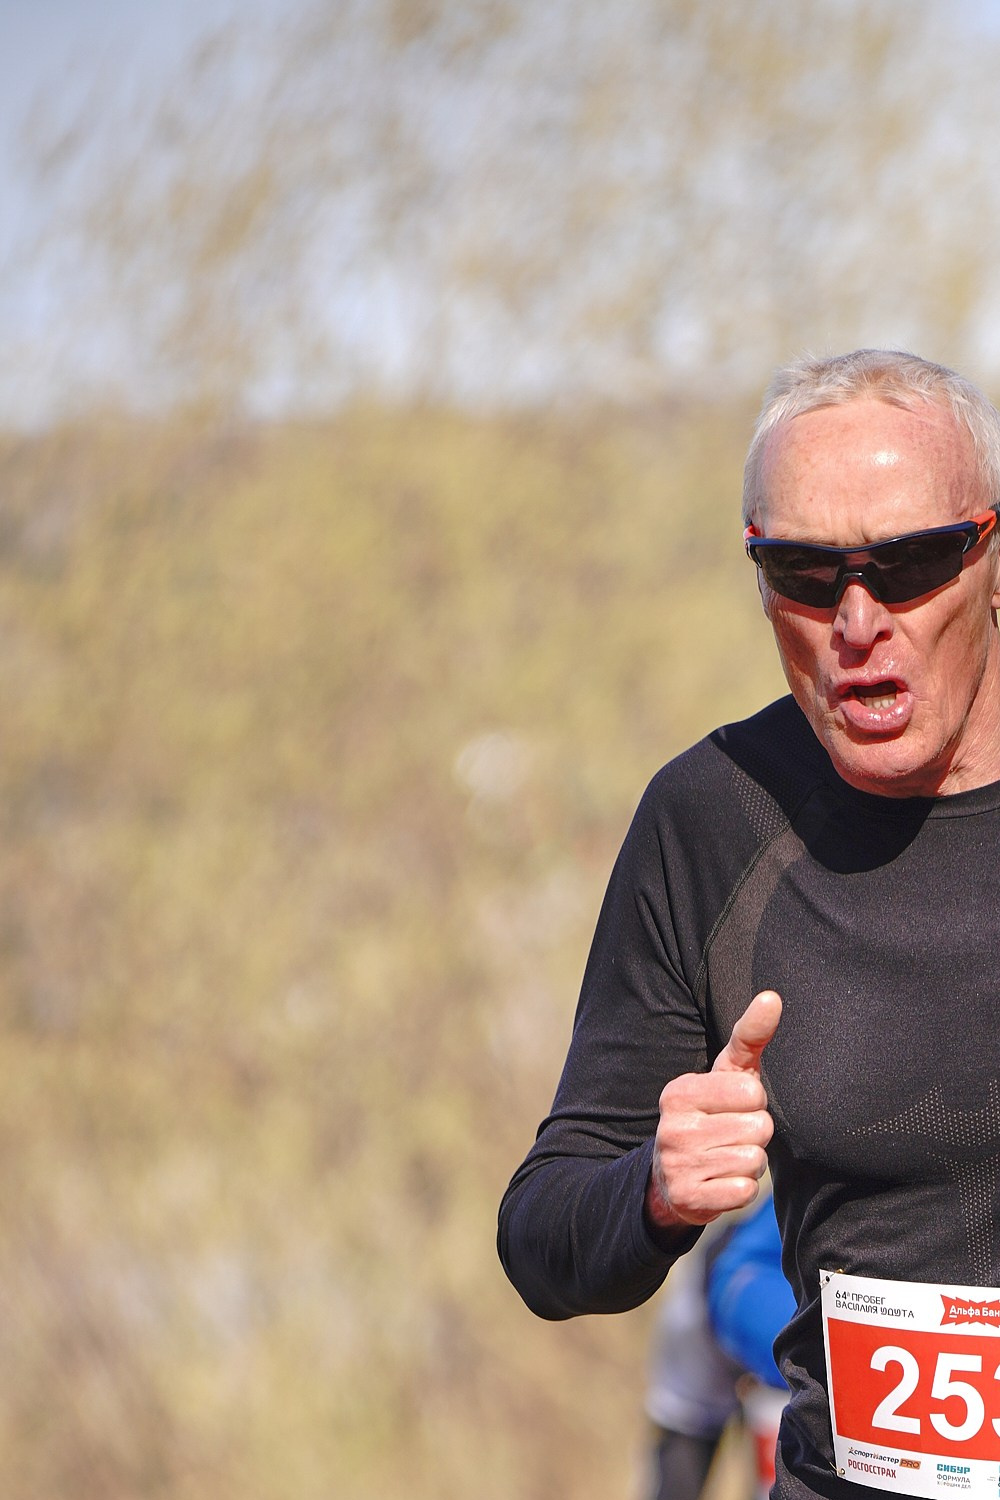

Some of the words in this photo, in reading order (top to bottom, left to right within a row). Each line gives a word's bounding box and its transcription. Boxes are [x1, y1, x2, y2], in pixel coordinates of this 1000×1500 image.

[852, 1293, 886, 1305] ПРОБЕГ
[835, 1300, 878, 1314] ВАСИЛИЯ
[949, 1305, 980, 1318] Альфа
[848, 1458, 897, 1479] РОСГОССТРАХ
[900, 1458, 920, 1469] PRO
[936, 1463, 971, 1474] СИБУР
[936, 1473, 971, 1484] ФОРМУЛА
[936, 1480, 960, 1488] ХРОШИХ
